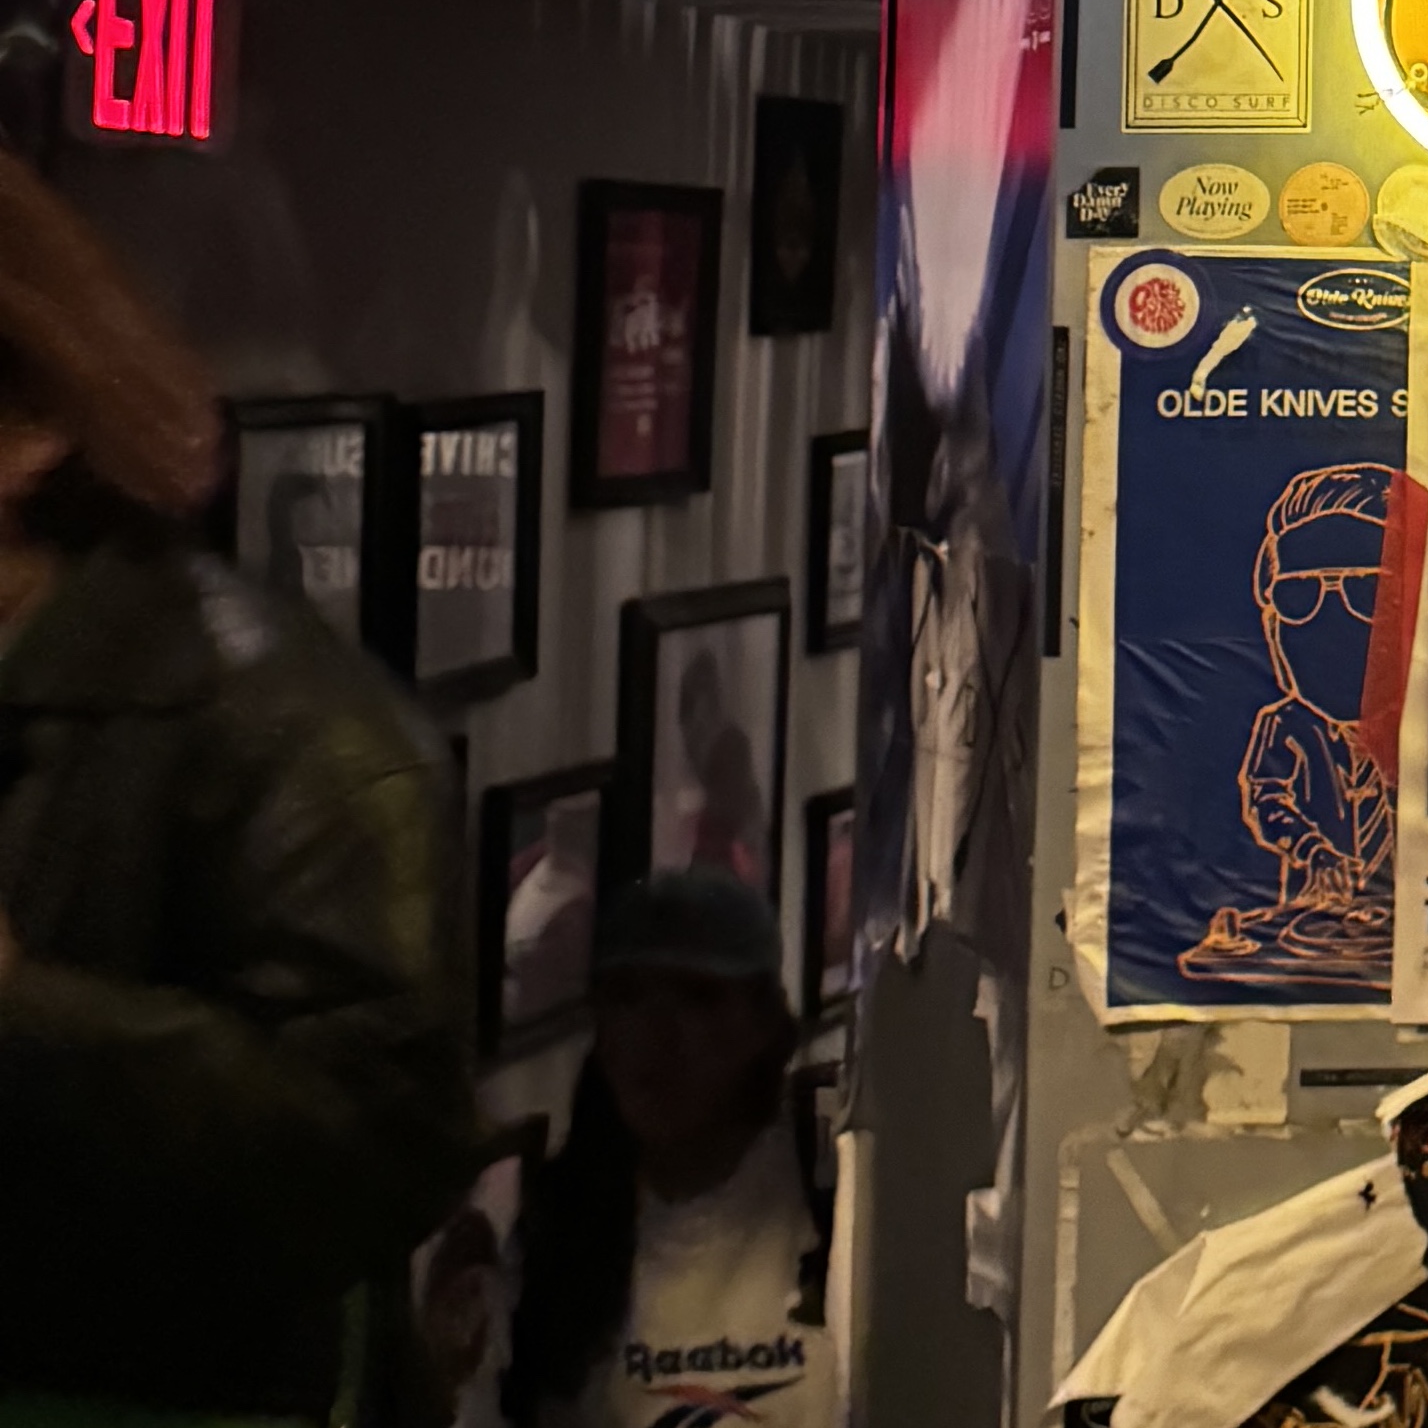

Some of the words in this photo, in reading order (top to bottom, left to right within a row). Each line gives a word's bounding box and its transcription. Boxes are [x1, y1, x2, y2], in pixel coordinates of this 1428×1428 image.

[1142, 95, 1218, 111] DISCO
[1232, 95, 1293, 110] SURF
[1194, 176, 1238, 197] Now
[1175, 195, 1253, 222] Playing
[1157, 389, 1248, 418] OLDE
[1260, 389, 1379, 418] KNIVES
